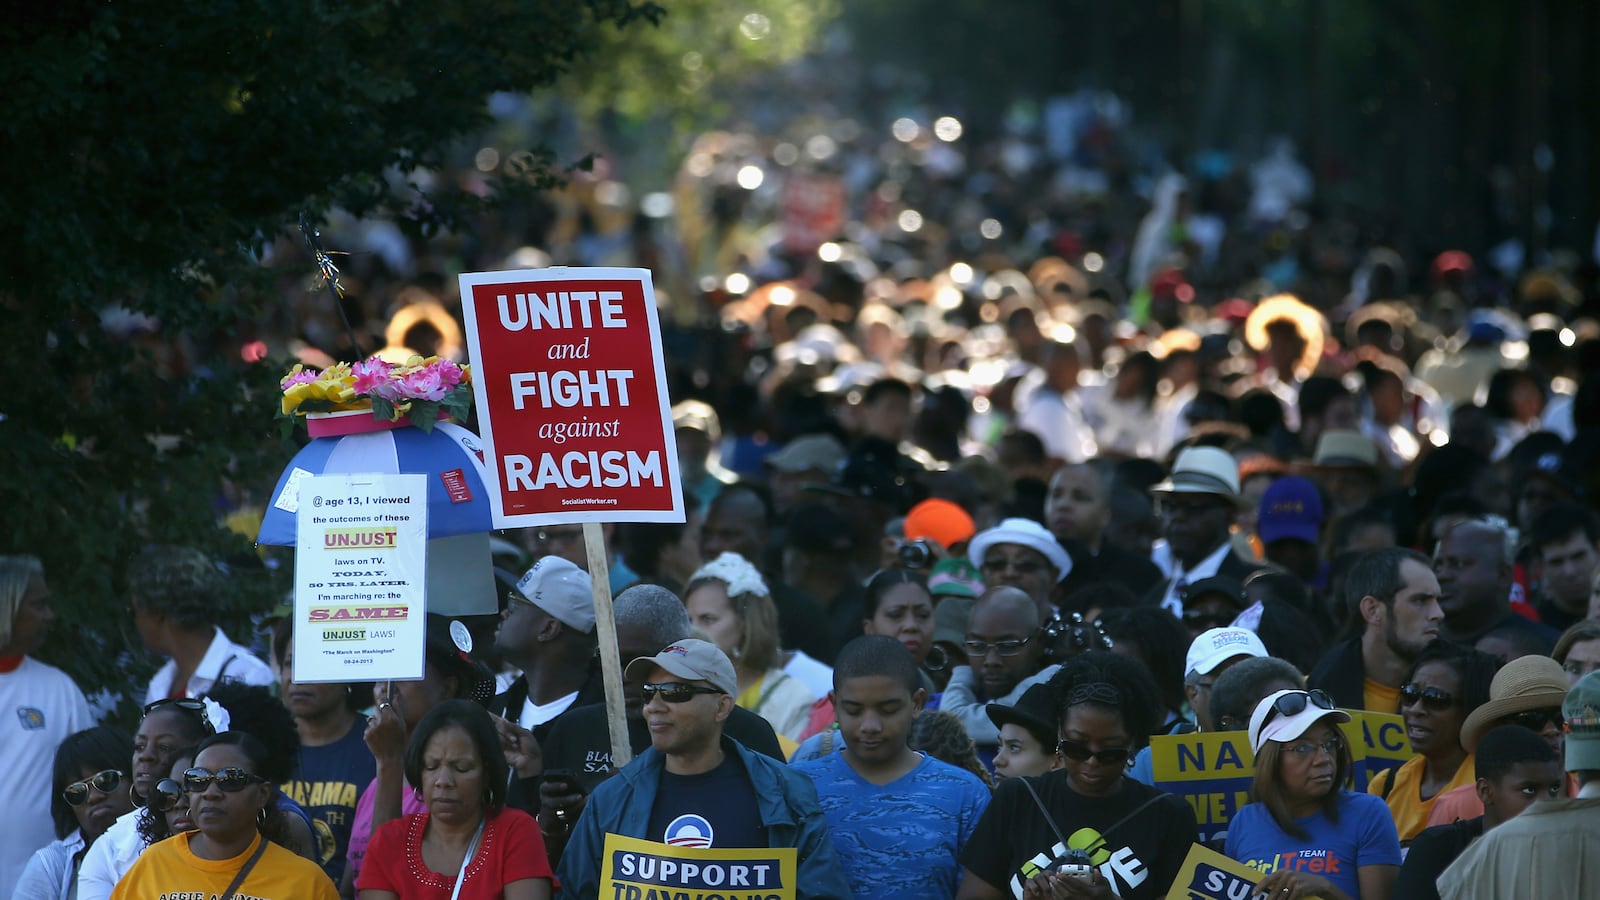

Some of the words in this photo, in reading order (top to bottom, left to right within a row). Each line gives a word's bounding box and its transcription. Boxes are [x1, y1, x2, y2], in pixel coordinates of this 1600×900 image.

[497, 291, 627, 332] UNITE
[547, 336, 590, 360] and
[510, 370, 634, 410] FIGHT
[538, 415, 620, 444] against
[503, 450, 664, 491] RACISM
[312, 495, 323, 508] @
[325, 499, 344, 507] age
[347, 496, 363, 506] 13,
[372, 496, 410, 504] viewed
[561, 498, 618, 506] SocialistWorker.org
[329, 515, 371, 523] outcomes
[374, 514, 383, 522] of
[385, 514, 410, 522] these
[324, 532, 397, 547] UNJUST
[334, 558, 355, 566] laws
[370, 557, 385, 565] TV.
[332, 570, 387, 578] TODAY,
[318, 593, 331, 601] I'm
[333, 592, 372, 601] marching
[387, 591, 401, 599] the
[308, 606, 408, 621] SAME
[322, 630, 366, 640] UNJUST
[370, 630, 396, 639] LAWS!
[1177, 740, 1257, 772] NA
[1299, 850, 1326, 858] TEAM
[620, 853, 770, 886] SUPPORT
